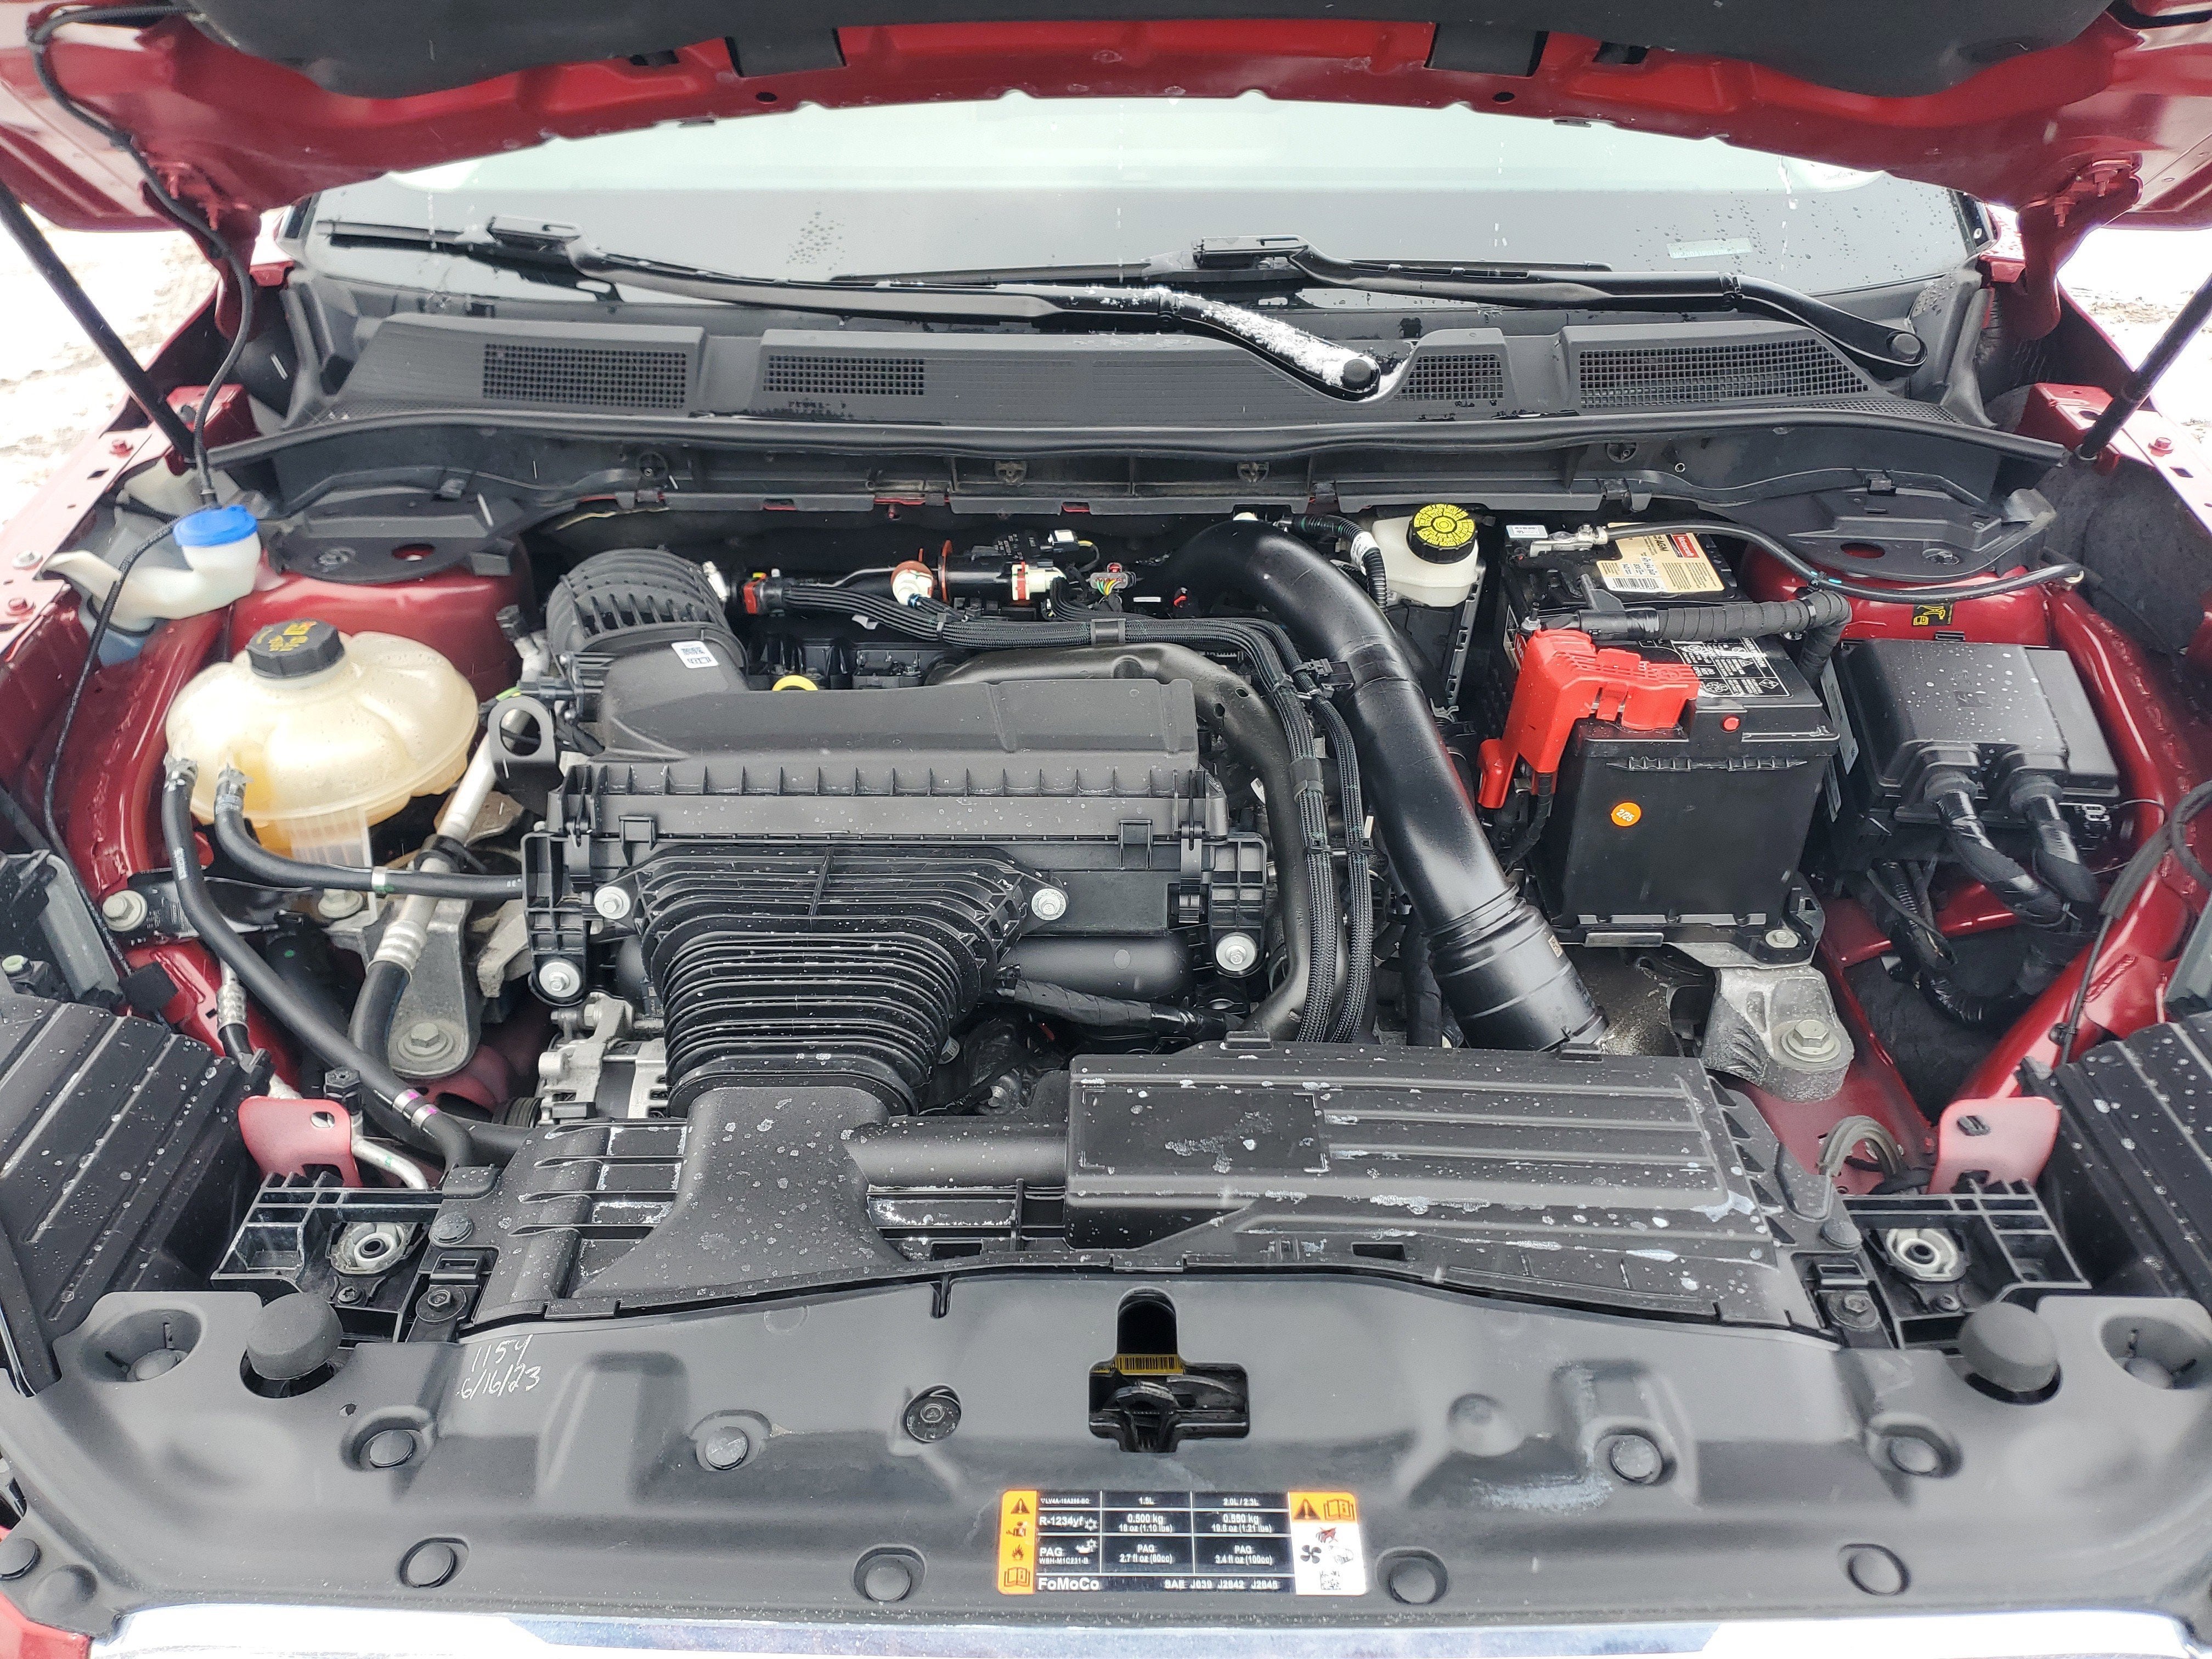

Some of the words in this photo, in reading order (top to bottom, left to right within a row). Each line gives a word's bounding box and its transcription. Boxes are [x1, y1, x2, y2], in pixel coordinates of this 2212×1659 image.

[1655, 539, 1669, 551] AGM
[1616, 809, 1635, 822] 2/25
[1039, 1515, 1084, 1528] R-1234yf
[1127, 1514, 1150, 1522] 0.500
[1153, 1513, 1164, 1525] kg
[1248, 1513, 1259, 1525] kg
[1040, 1547, 1063, 1557] PAG
[1137, 1544, 1156, 1553] PAG
[1234, 1545, 1253, 1554] PAG
[1119, 1553, 1131, 1563] 2.7
[1215, 1554, 1227, 1564] 3.4
[1038, 1577, 1100, 1590] FoMoCo
